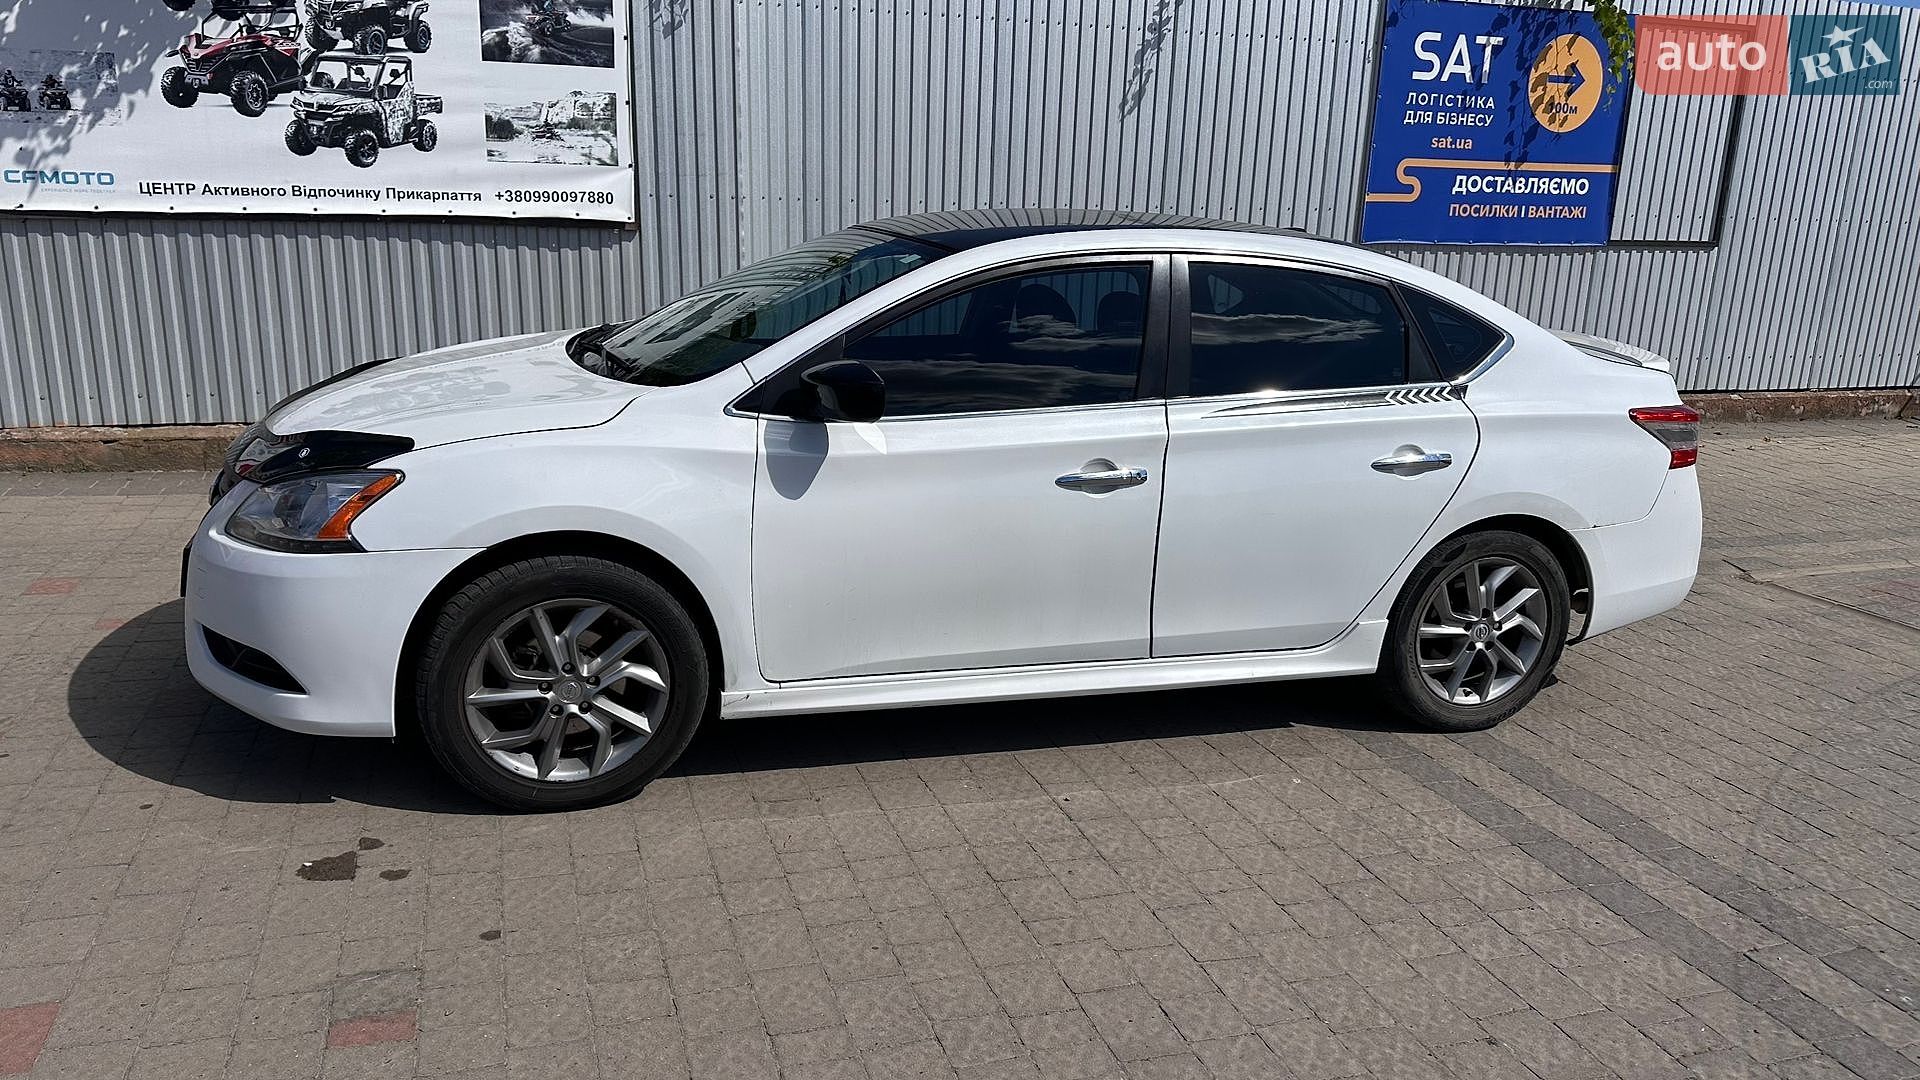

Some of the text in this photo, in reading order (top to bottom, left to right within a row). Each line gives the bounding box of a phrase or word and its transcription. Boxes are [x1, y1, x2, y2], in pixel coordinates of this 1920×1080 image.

[1412, 31, 1504, 84] SAT
[1406, 92, 1495, 109] ЛОГІСТИКА
[1404, 110, 1494, 127] ДЛЯ БІЗНЕСУ
[1431, 135, 1473, 150] sat.ua
[4, 170, 115, 185] CFMOTO
[1451, 175, 1590, 195] ДОСТАВЛЯЄМО
[139, 182, 614, 205] ЦЕНТР Активного Відпочинку Прикарпаття +380990097880
[1449, 203, 1587, 219] ПОСИЛКИ І ВАНТАЖІ
